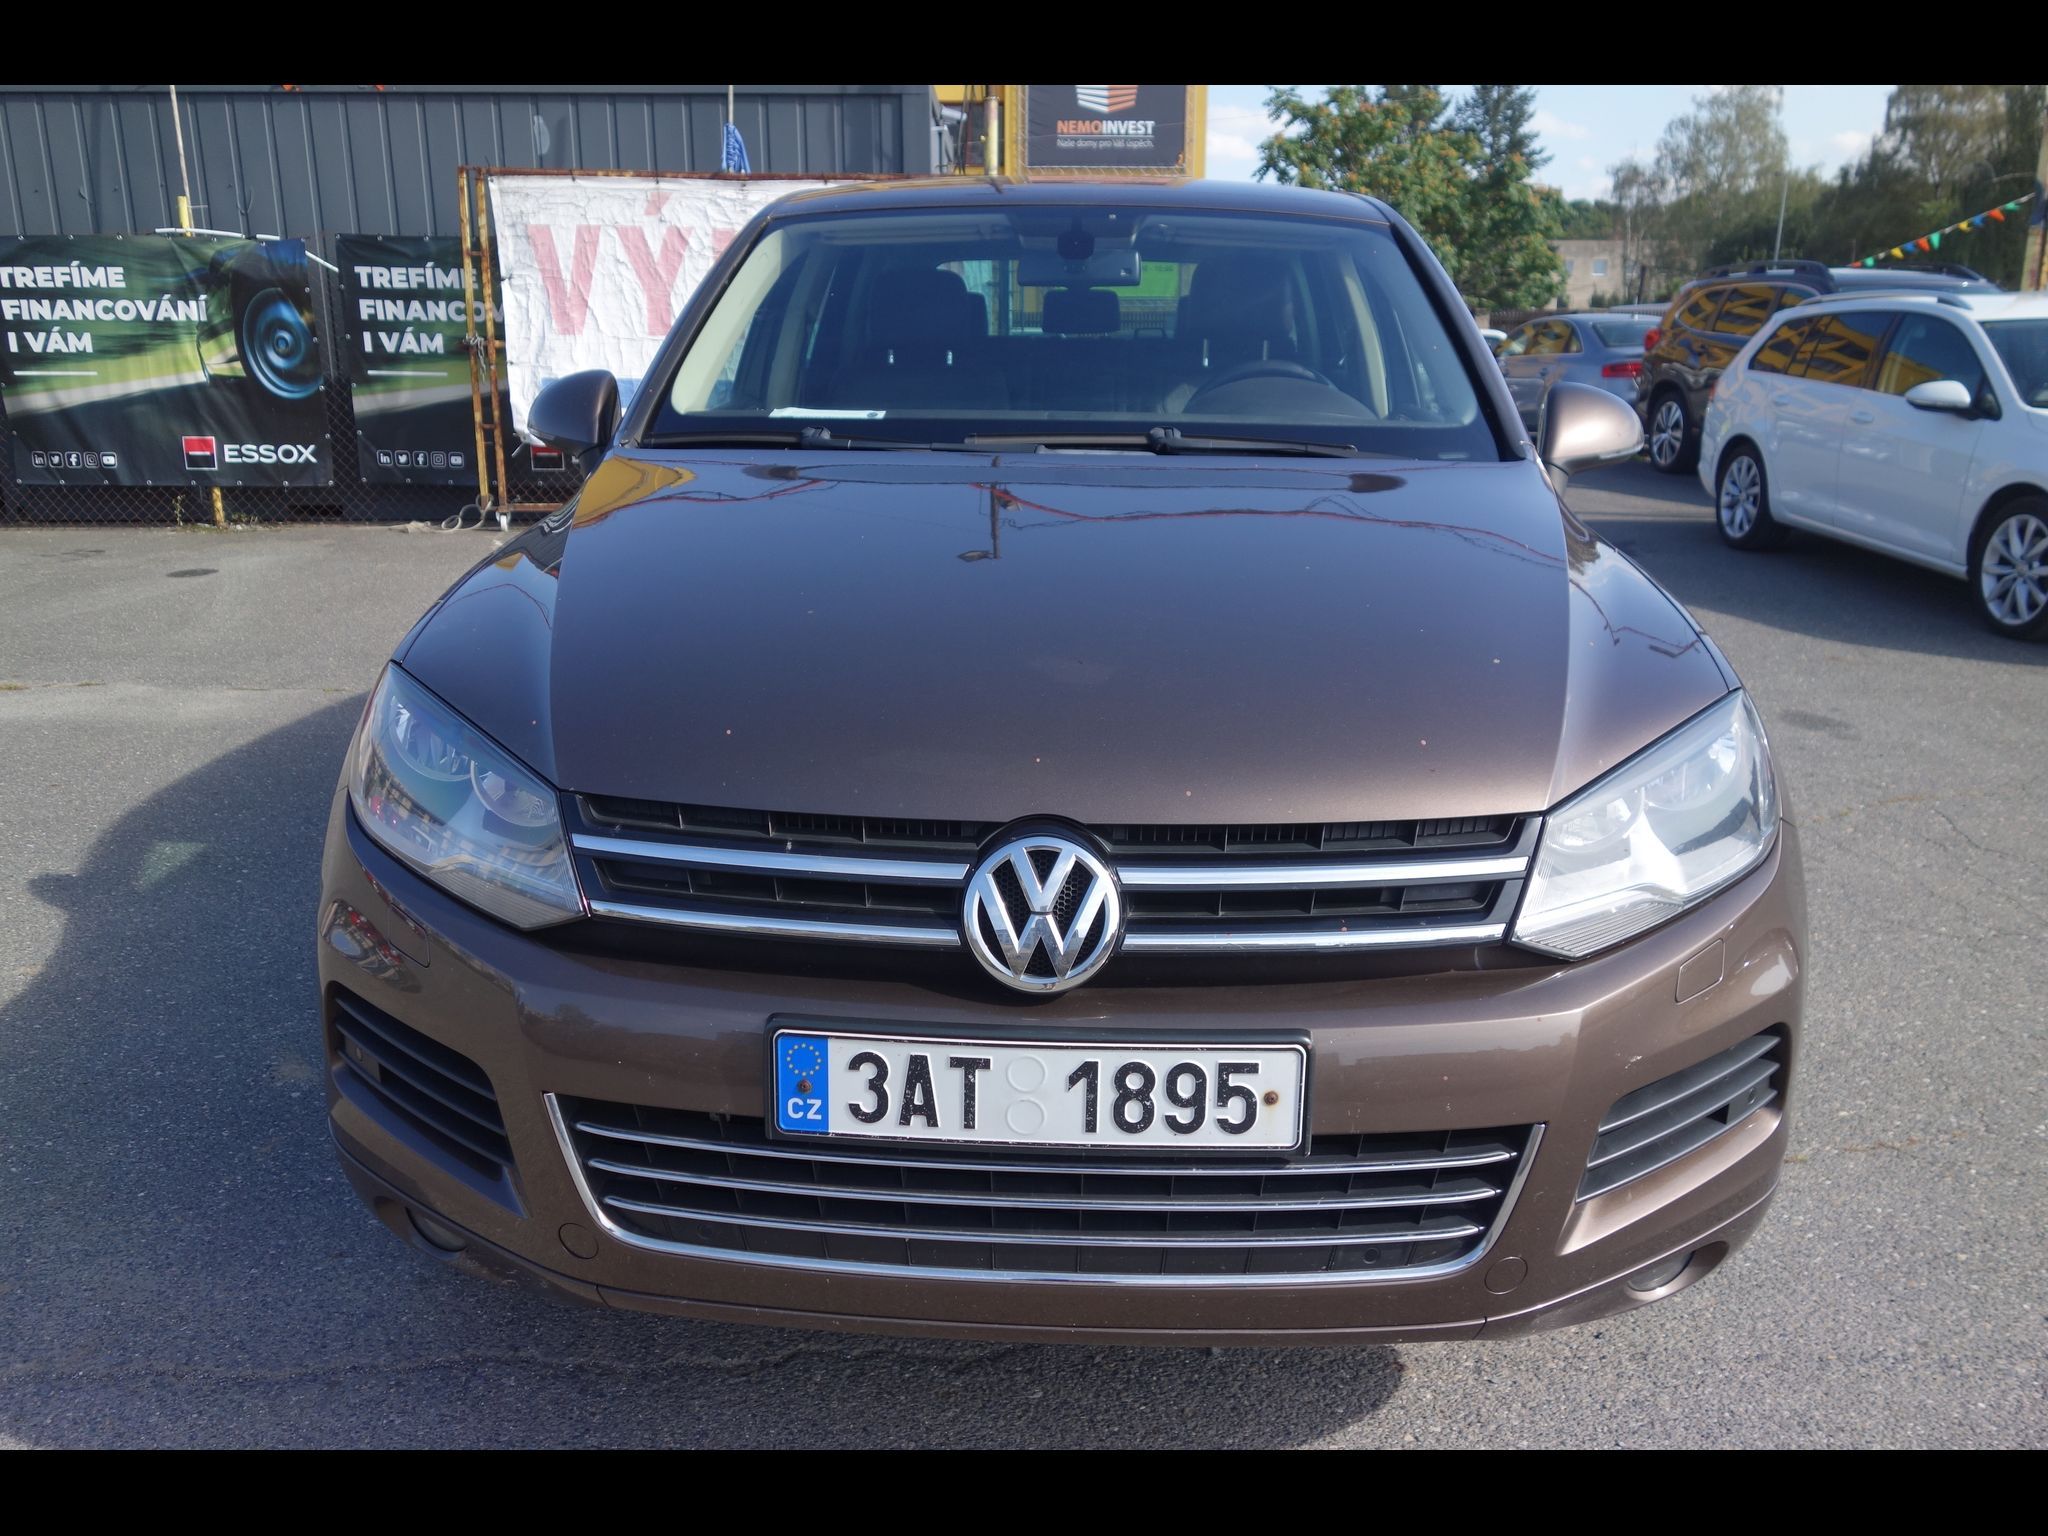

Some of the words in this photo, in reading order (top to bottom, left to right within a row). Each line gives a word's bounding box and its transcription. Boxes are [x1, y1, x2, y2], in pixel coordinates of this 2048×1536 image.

[1057, 120, 1155, 135] NEMOINVEST
[0, 261, 126, 288] TREFÍME
[354, 262, 478, 289] TREFÍME
[2, 294, 208, 321] FINANCOVÁNÍ
[8, 331, 18, 353] I
[24, 326, 93, 353] VÁM
[363, 331, 373, 353] I
[378, 327, 444, 354] VÁM
[224, 443, 318, 464] ESSOX
[787, 1097, 822, 1121] CZ
[847, 1051, 992, 1131] 3AT
[1067, 1060, 1260, 1135] 1895
